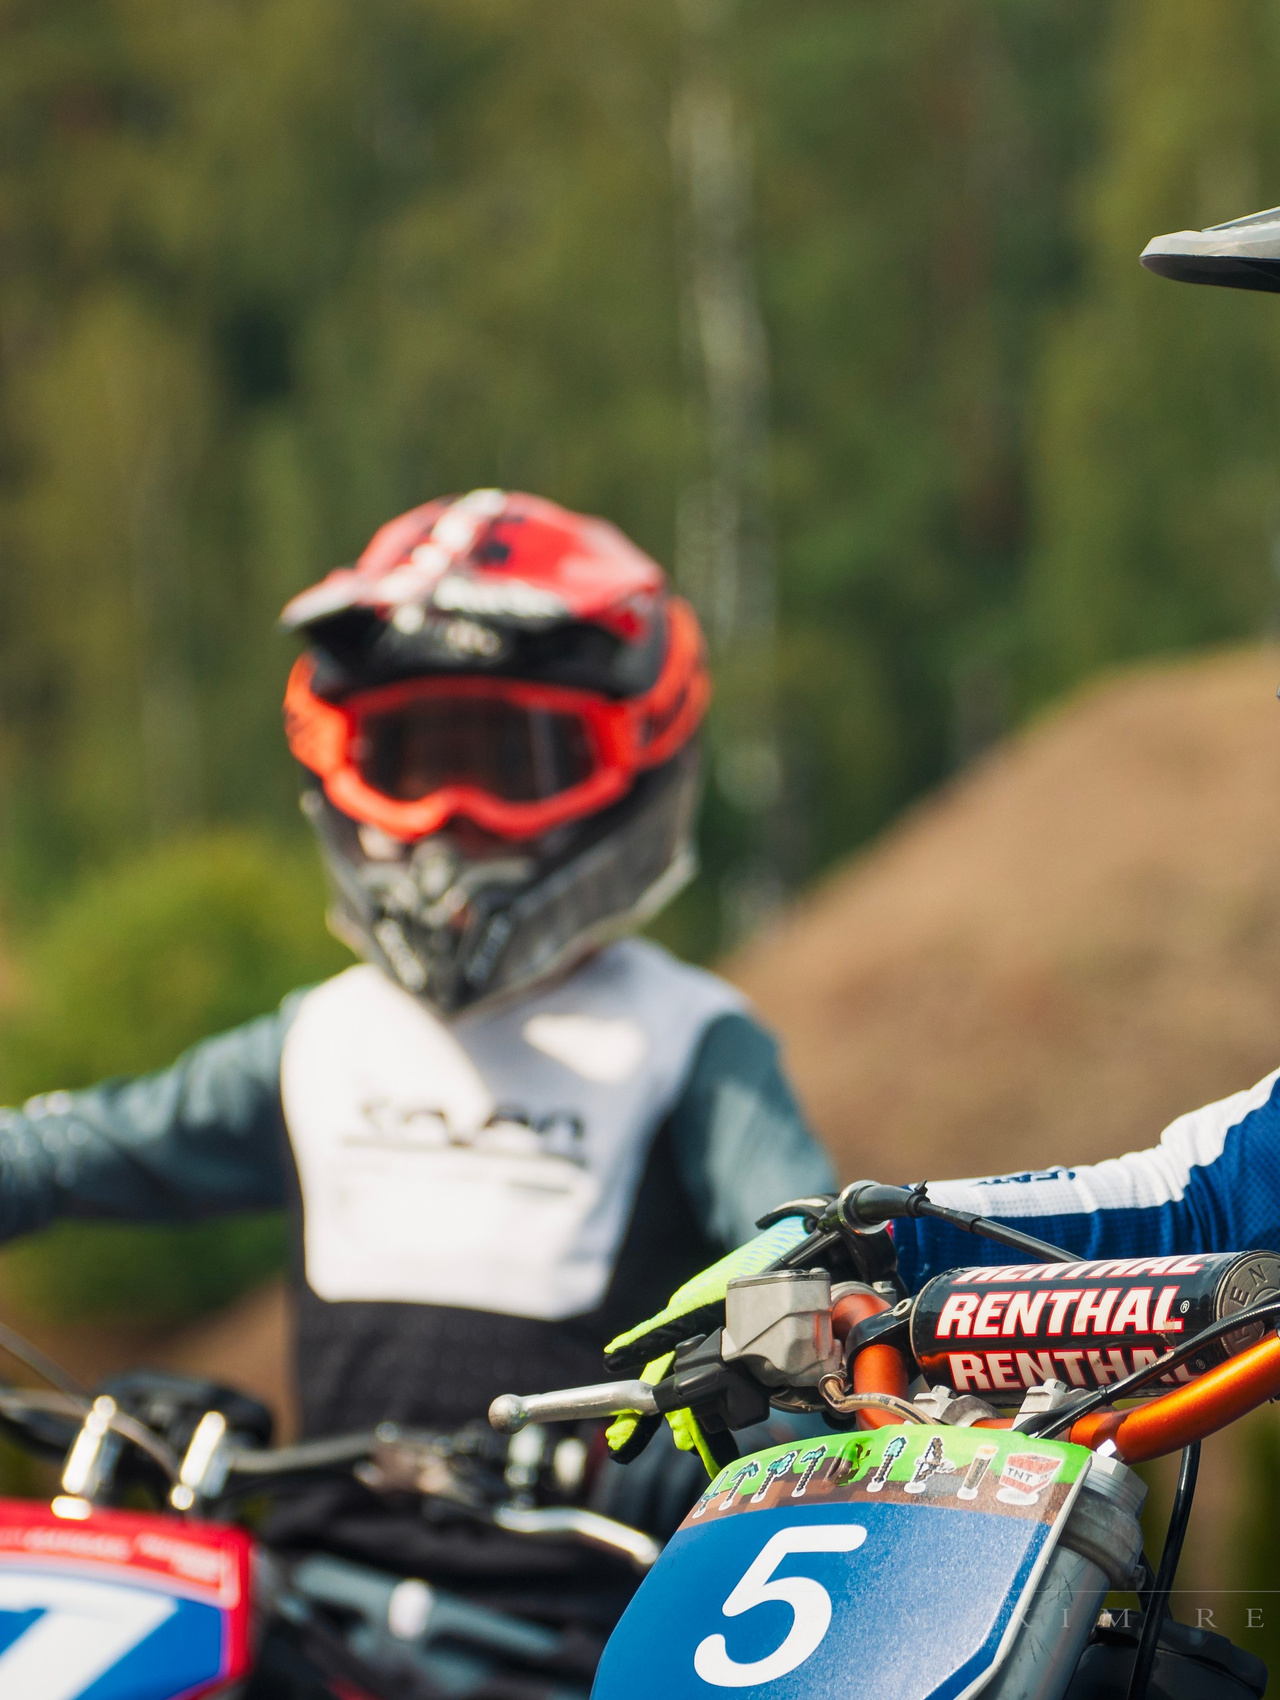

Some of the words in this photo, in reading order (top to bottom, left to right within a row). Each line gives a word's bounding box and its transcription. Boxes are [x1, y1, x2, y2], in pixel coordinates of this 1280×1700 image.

[935, 1286, 1184, 1339] RENTHAL
[1007, 1467, 1033, 1482] TNT
[693, 1524, 868, 1688] 5
